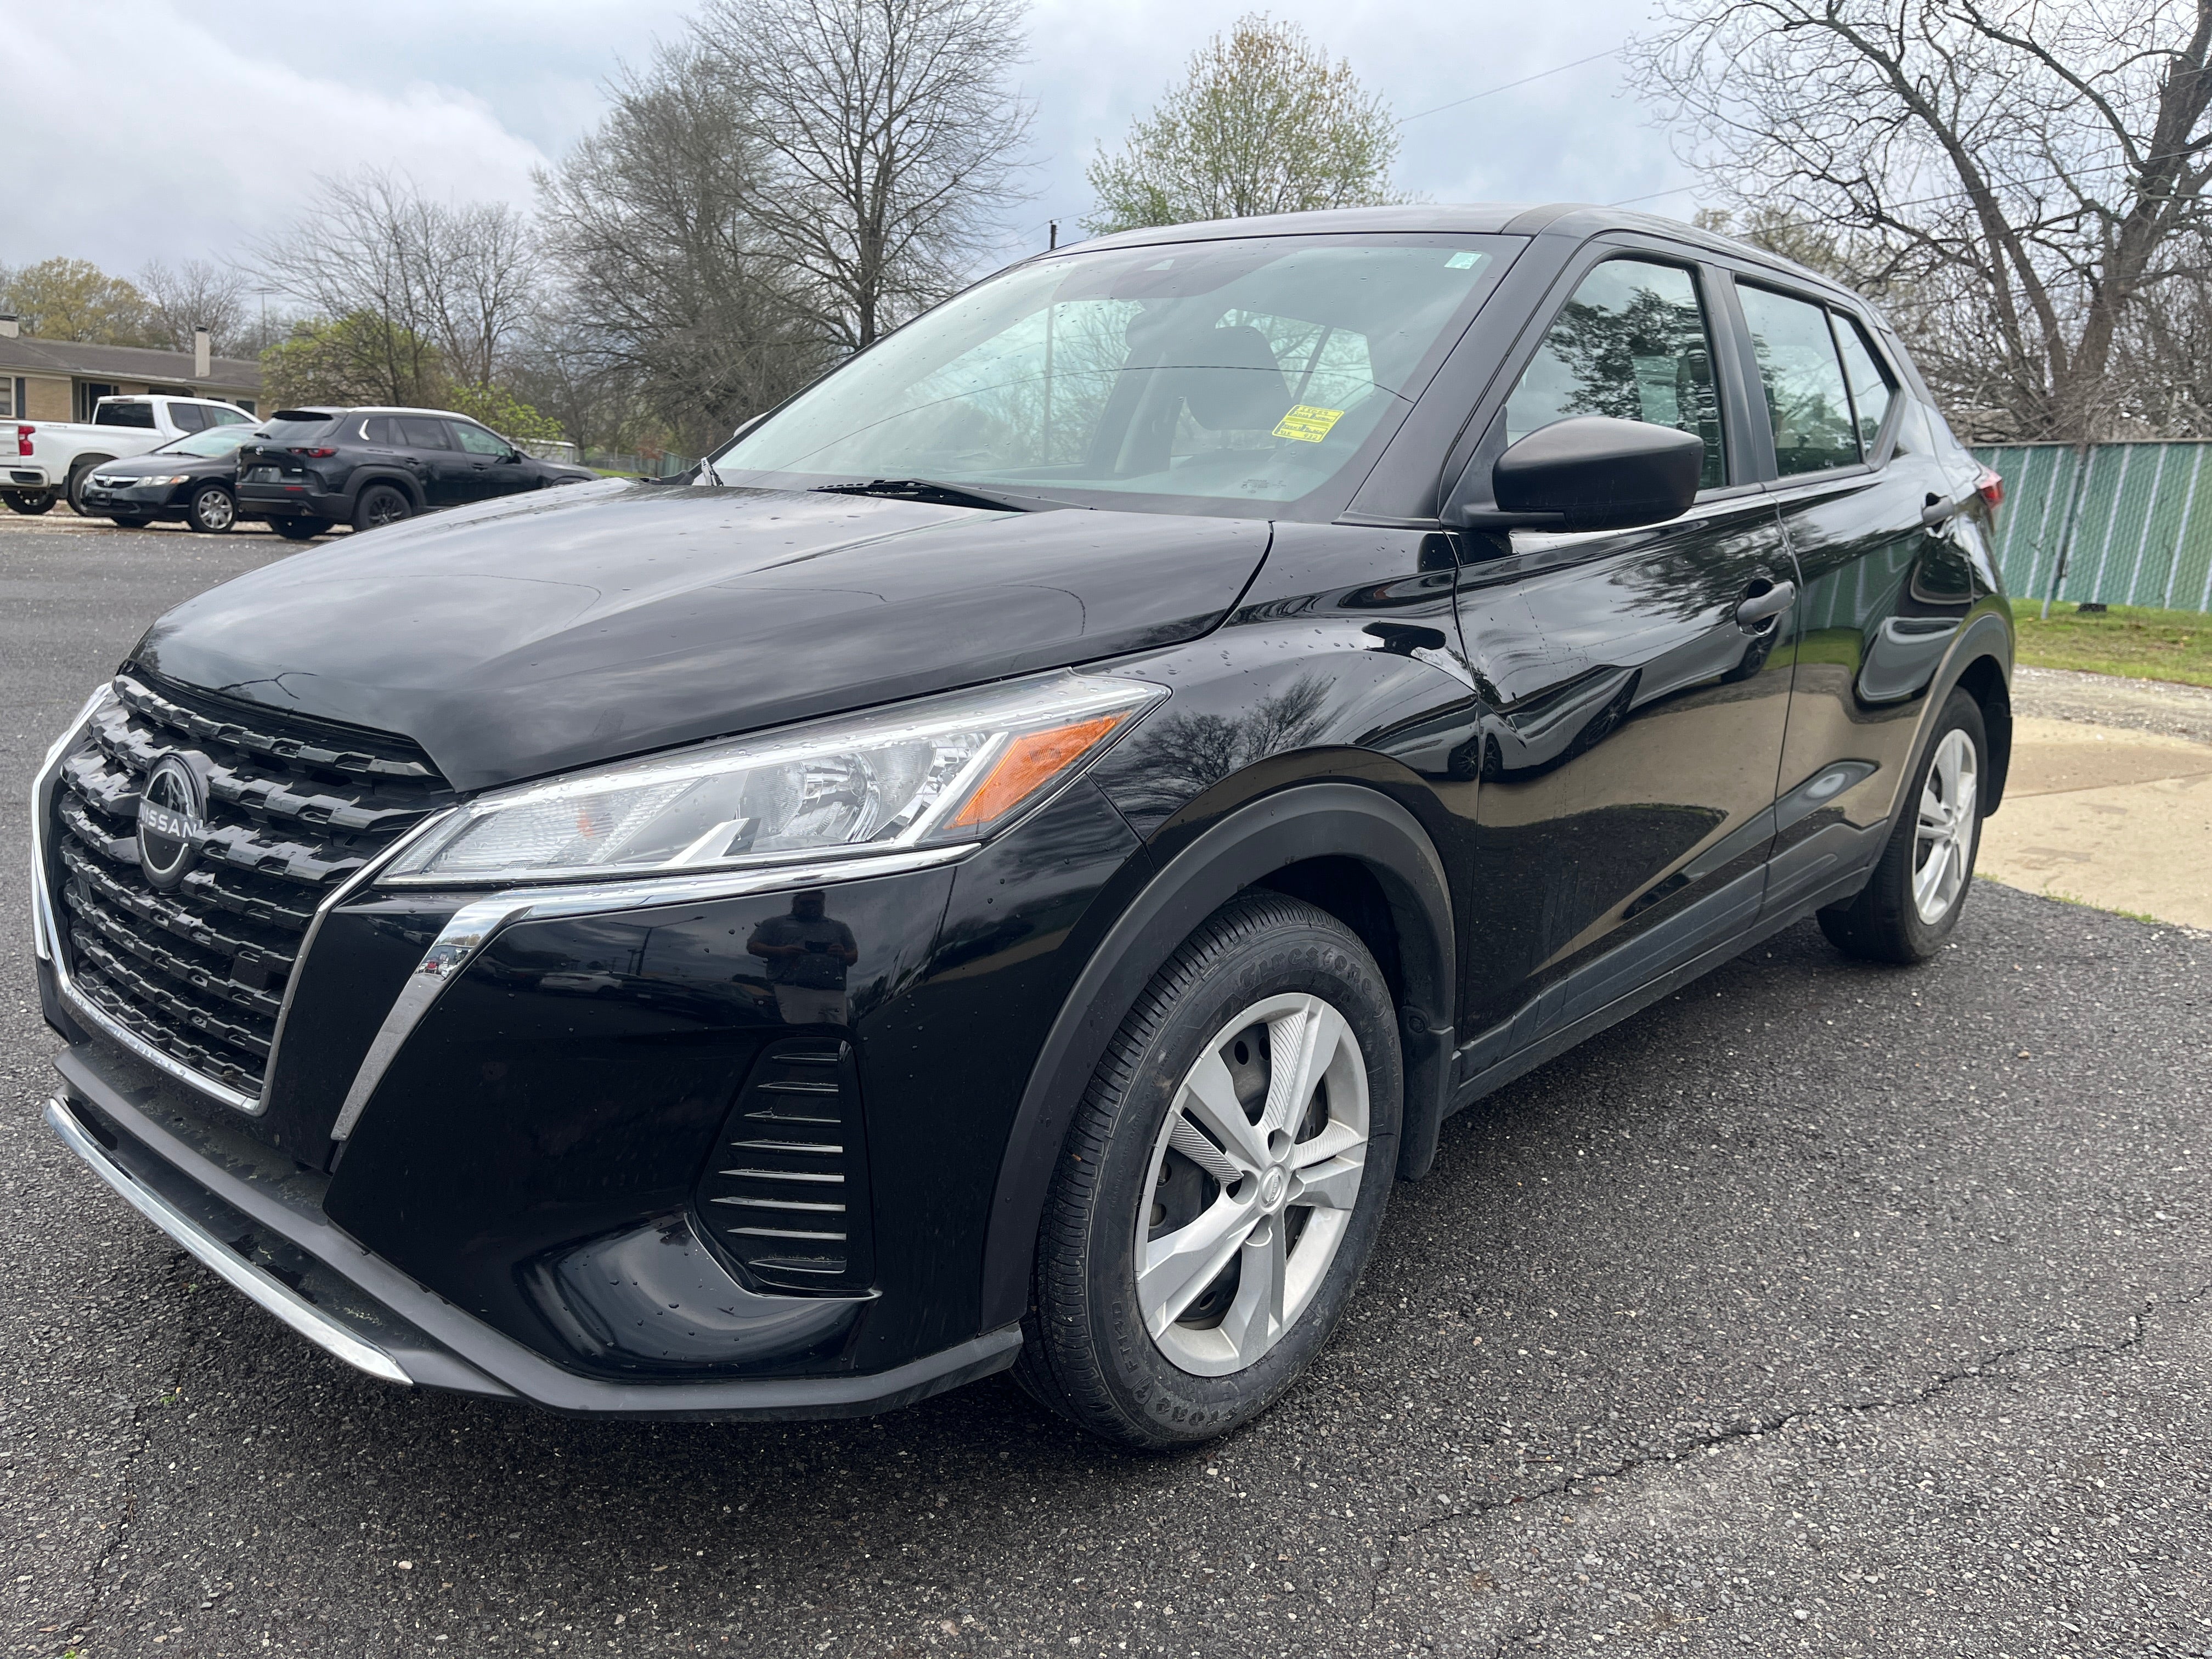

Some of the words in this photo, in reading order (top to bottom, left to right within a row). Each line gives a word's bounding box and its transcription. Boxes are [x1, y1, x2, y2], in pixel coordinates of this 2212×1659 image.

[139, 802, 197, 838] NISSAN
[1240, 946, 1373, 996] Firestone
[1111, 1301, 1138, 1374] FT140
